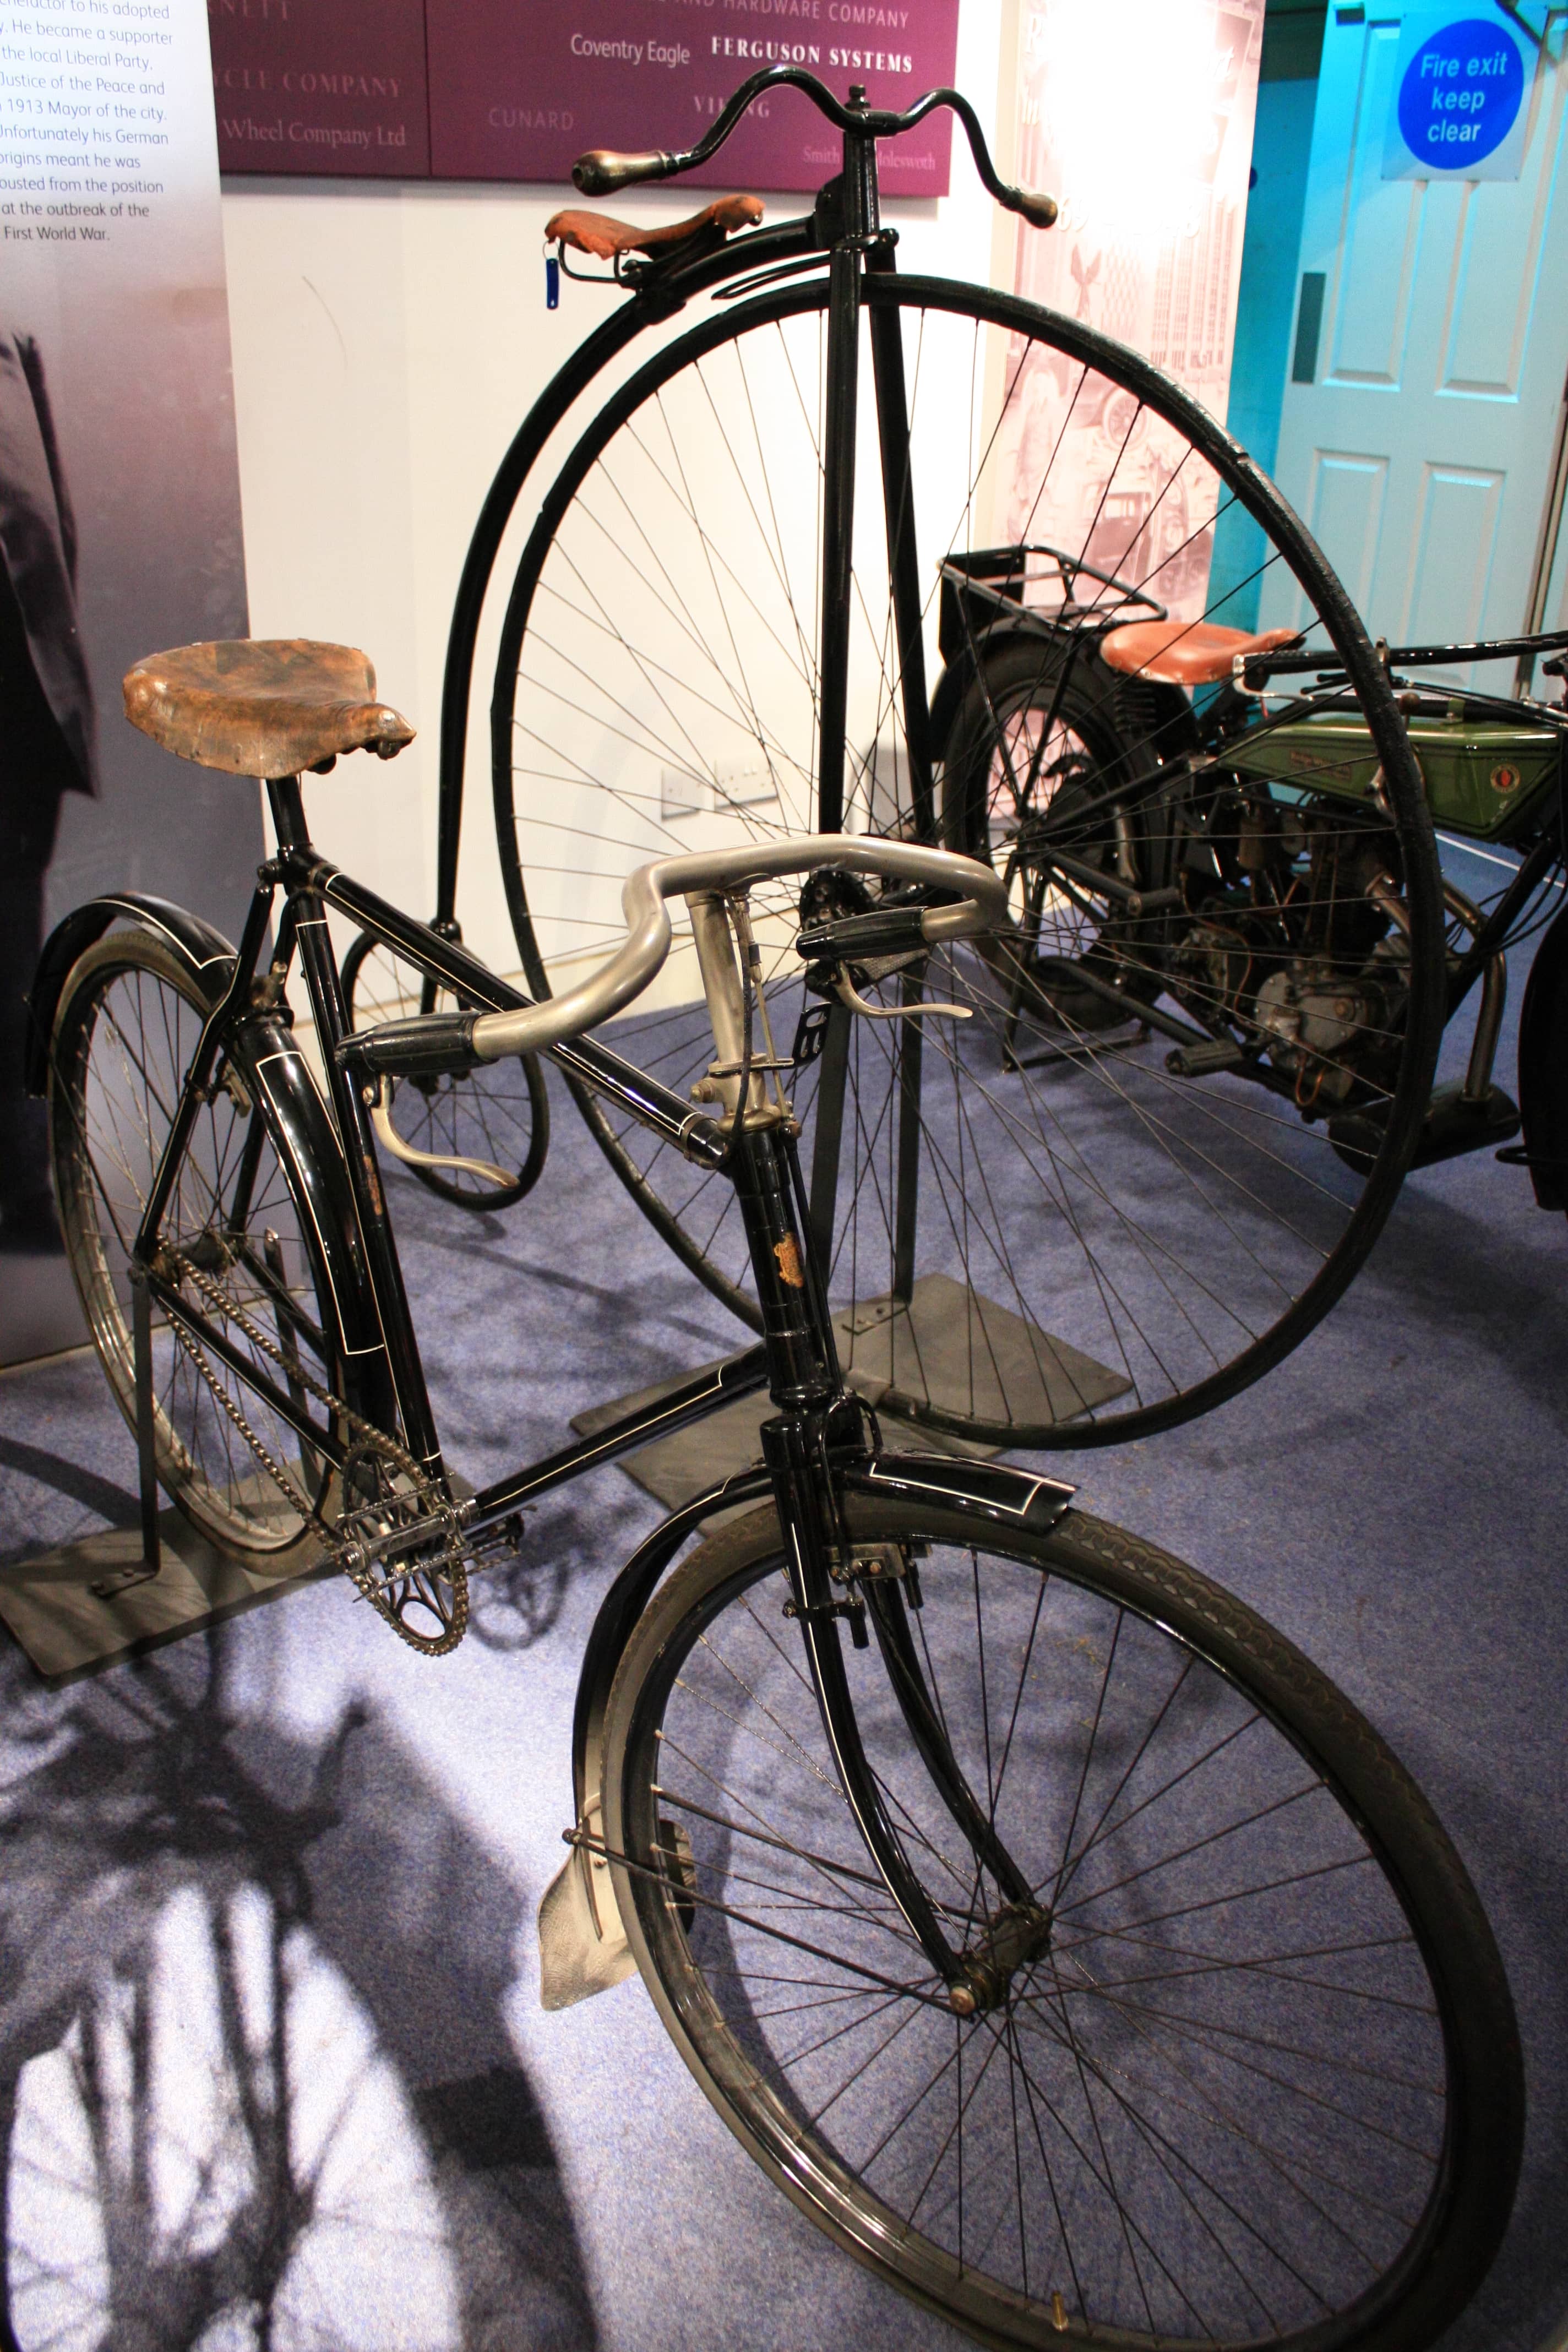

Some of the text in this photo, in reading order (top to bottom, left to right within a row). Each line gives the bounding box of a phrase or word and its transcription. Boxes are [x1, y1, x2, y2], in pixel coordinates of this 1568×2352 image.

[70, 0, 85, 12] to
[90, 0, 108, 14] his
[113, 2, 170, 20] adopted
[828, 3, 908, 29] COMPANY
[13, 18, 31, 34] He
[36, 20, 92, 39] became
[97, 29, 105, 40] a
[110, 30, 173, 45] supporter
[2, 45, 25, 61] the
[30, 47, 62, 63] local
[67, 50, 110, 67] Liberal
[571, 33, 690, 68] Coventry Eagle
[711, 36, 912, 73] FERGUSON SYSTEMS
[1420, 51, 1507, 78] Fire exit
[51, 75, 64, 89] of
[70, 77, 92, 91] the
[97, 77, 135, 93] Peace
[139, 81, 165, 95] and
[282, 72, 401, 97] COMPANY
[8, 98, 43, 114] 1913
[48, 101, 91, 119] Mayor
[96, 103, 110, 117] of
[115, 104, 137, 119] the
[140, 107, 167, 123] city.
[1431, 86, 1485, 114] keep
[488, 107, 574, 130] CUNARD
[1428, 118, 1481, 143] clear
[93, 127, 112, 143] his
[116, 129, 169, 145] German
[222, 118, 407, 149] Wheel Company Ltd
[46, 154, 90, 167] meant
[95, 153, 111, 168] he
[115, 159, 141, 169] was
[803, 145, 840, 164] Smith
[0, 176, 164, 196] ousted from the position
[2, 201, 150, 217] at the outbreak of the
[4, 225, 110, 241] First World War.
